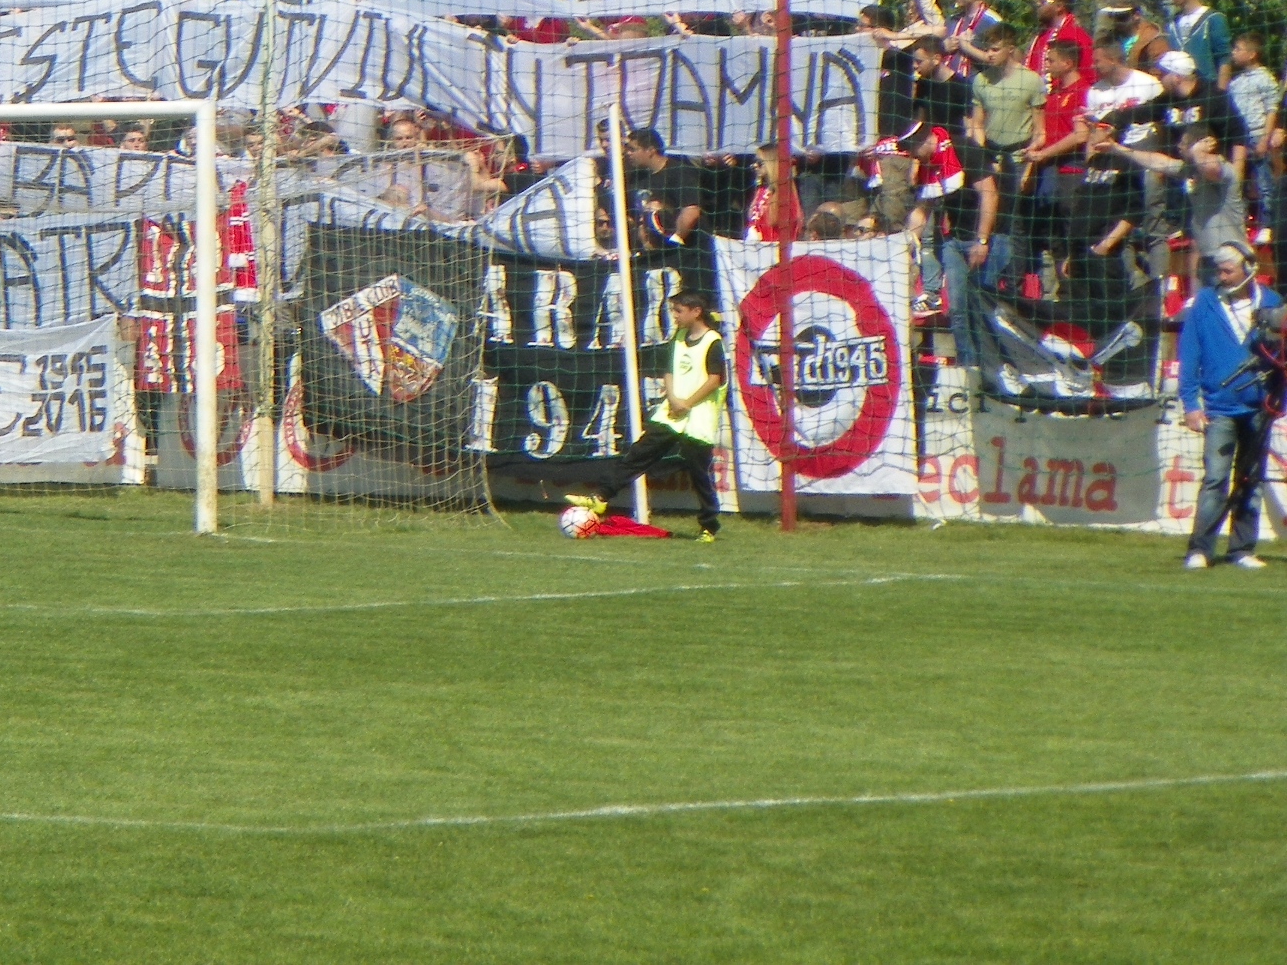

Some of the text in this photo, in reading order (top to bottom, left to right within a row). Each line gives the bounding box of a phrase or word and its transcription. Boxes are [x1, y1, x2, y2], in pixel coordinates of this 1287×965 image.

[35, 344, 108, 390] 1945
[22, 388, 108, 437] 2016
[464, 376, 679, 459] 194
[926, 387, 992, 414] ici
[917, 436, 1196, 519] eclama t
